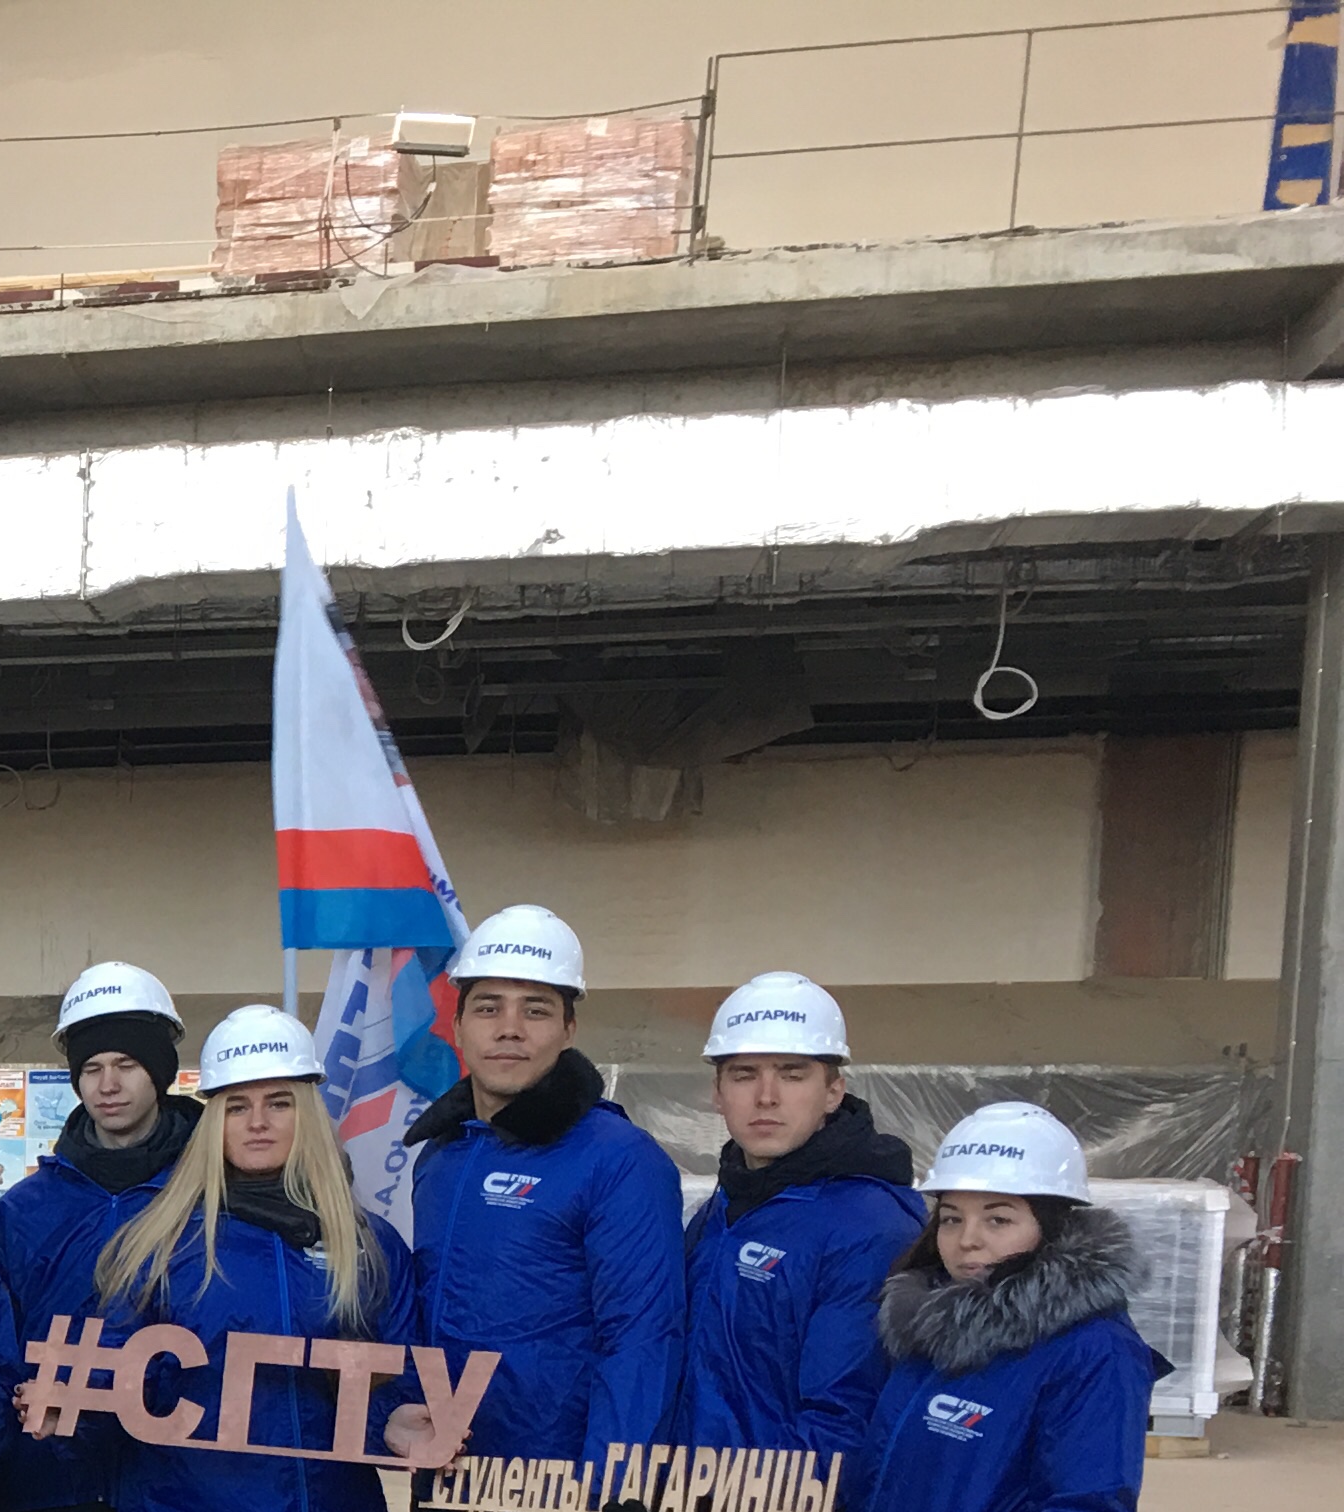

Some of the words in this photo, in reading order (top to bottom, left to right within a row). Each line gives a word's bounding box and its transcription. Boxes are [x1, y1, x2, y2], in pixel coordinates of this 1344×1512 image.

[488, 943, 552, 961] ГАГАРИН
[67, 985, 122, 1009] ГАГАРИН
[737, 1010, 806, 1024] ГАГАРИН
[226, 1042, 288, 1059] ГАГАРИН
[949, 1143, 1025, 1160] ГАГАРИН
[21, 1314, 503, 1468] #СГТУ
